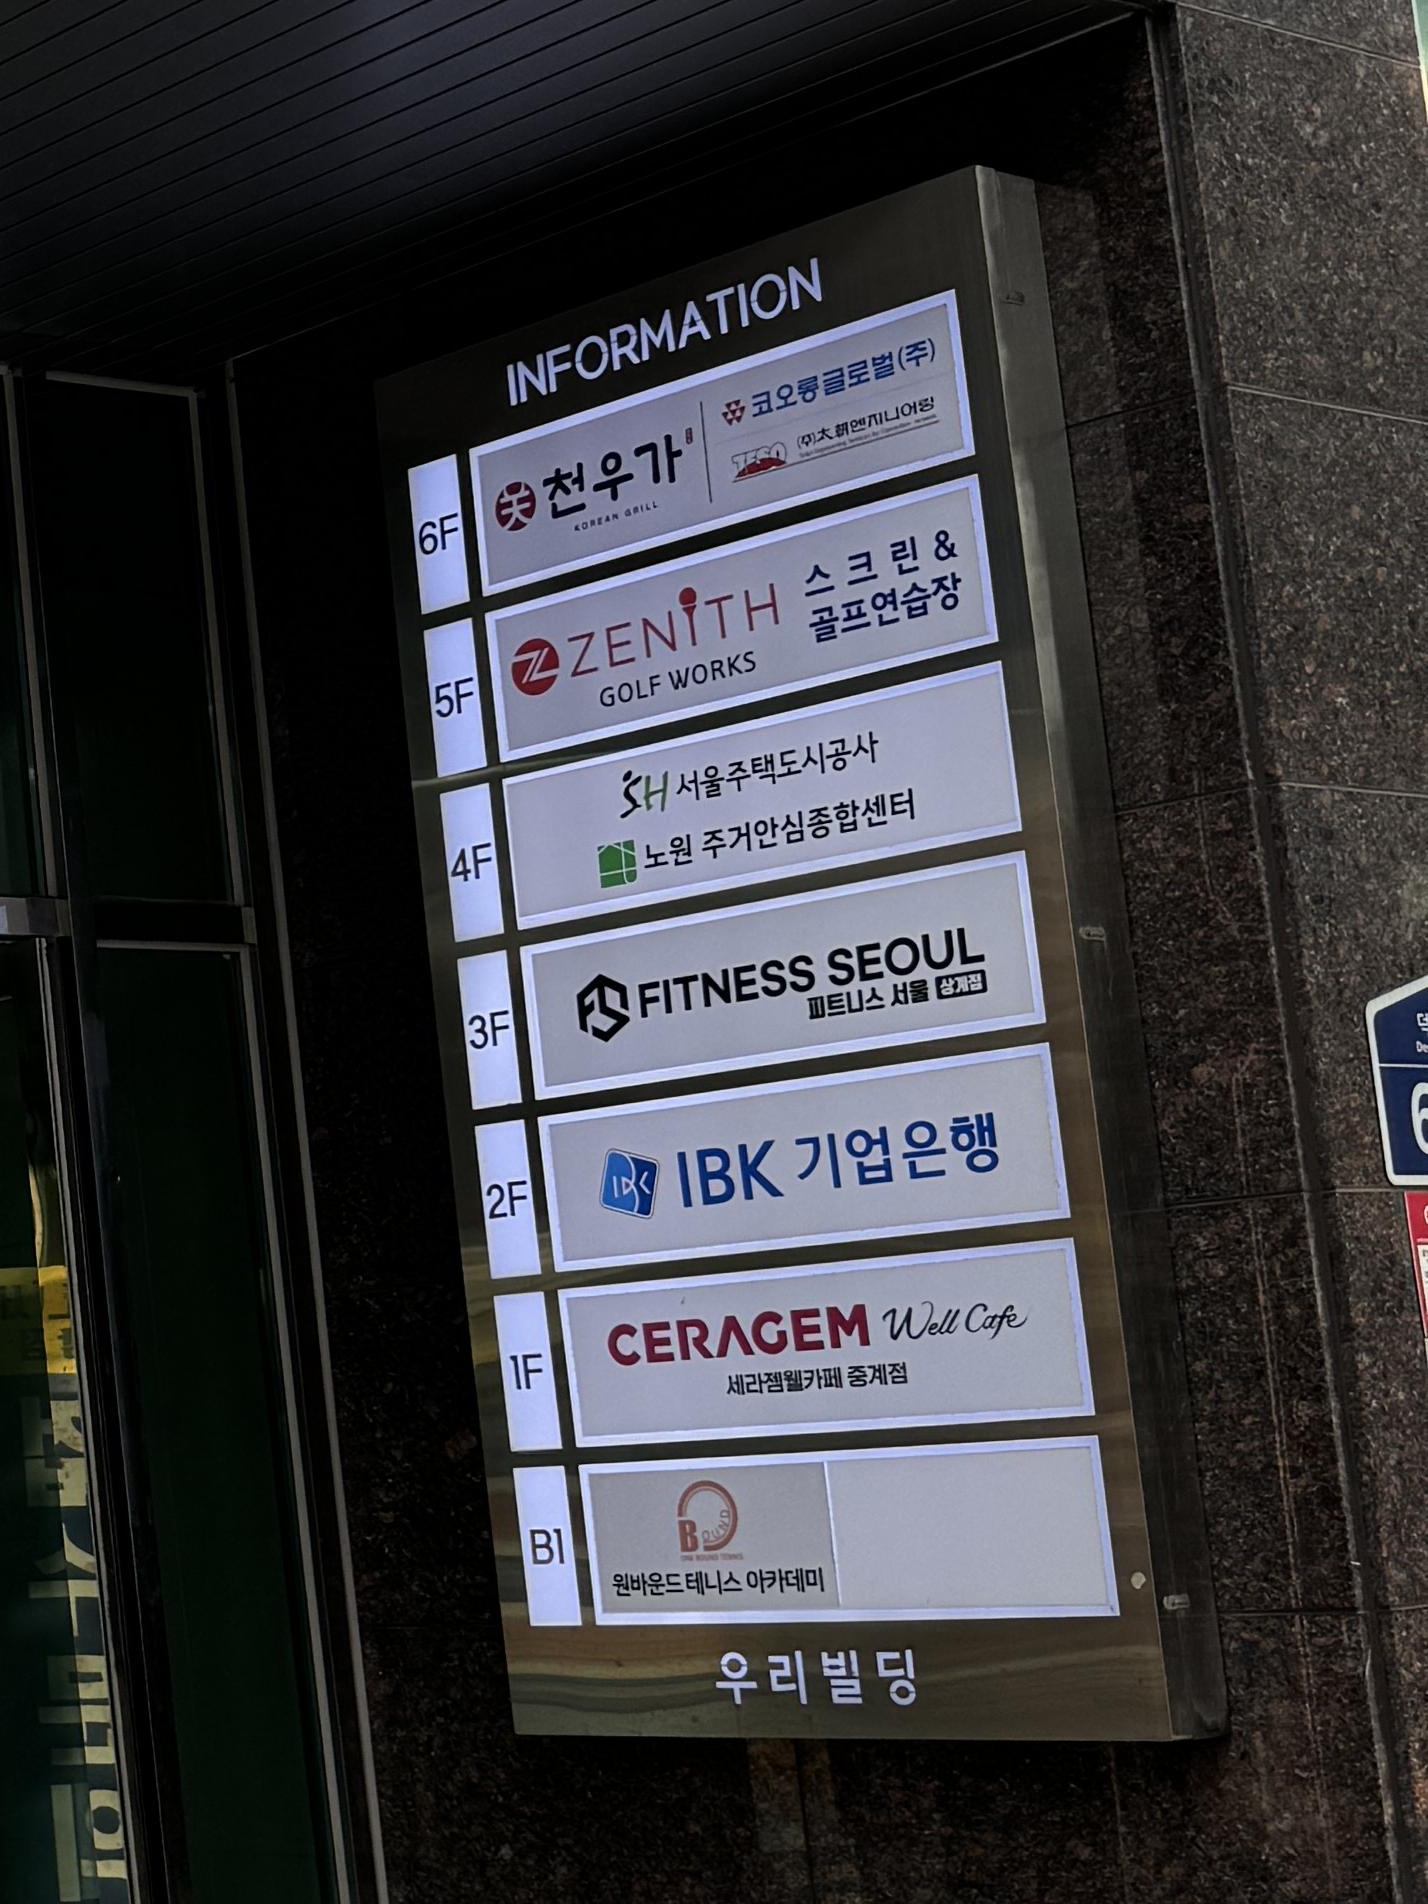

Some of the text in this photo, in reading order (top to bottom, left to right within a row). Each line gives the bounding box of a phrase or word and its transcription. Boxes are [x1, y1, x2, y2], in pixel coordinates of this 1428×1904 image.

[506, 257, 823, 406] INFORMATION
[752, 338, 935, 417] 코오롱글로벌(주)
[542, 435, 684, 520] 천우가
[419, 514, 459, 555] 6F
[575, 501, 659, 532] KOREAN GRILL
[808, 573, 963, 645] 골프연습장
[434, 677, 475, 718] 5F
[600, 651, 757, 709] GOLF WORKS
[676, 732, 879, 801] 서울주택도시공사
[644, 789, 916, 871] 노원 주거안심종합센터
[450, 842, 493, 883] 4F
[638, 954, 815, 1019] FITNESS
[828, 928, 985, 987] SEOUL
[808, 987, 885, 1021] 피트니스
[890, 978, 929, 1009] 서울
[468, 1010, 510, 1049] 3F
[676, 1112, 1000, 1207] IBK 기업은행
[486, 1181, 527, 1219] 2F
[606, 1301, 1027, 1367] CERAGEM Well Cafe
[510, 1352, 543, 1391] 1F
[847, 1362, 909, 1388] 중계점
[530, 1527, 564, 1565] B1
[746, 1567, 825, 1594] 아카데미
[715, 1648, 917, 1707] 우리빌딩
